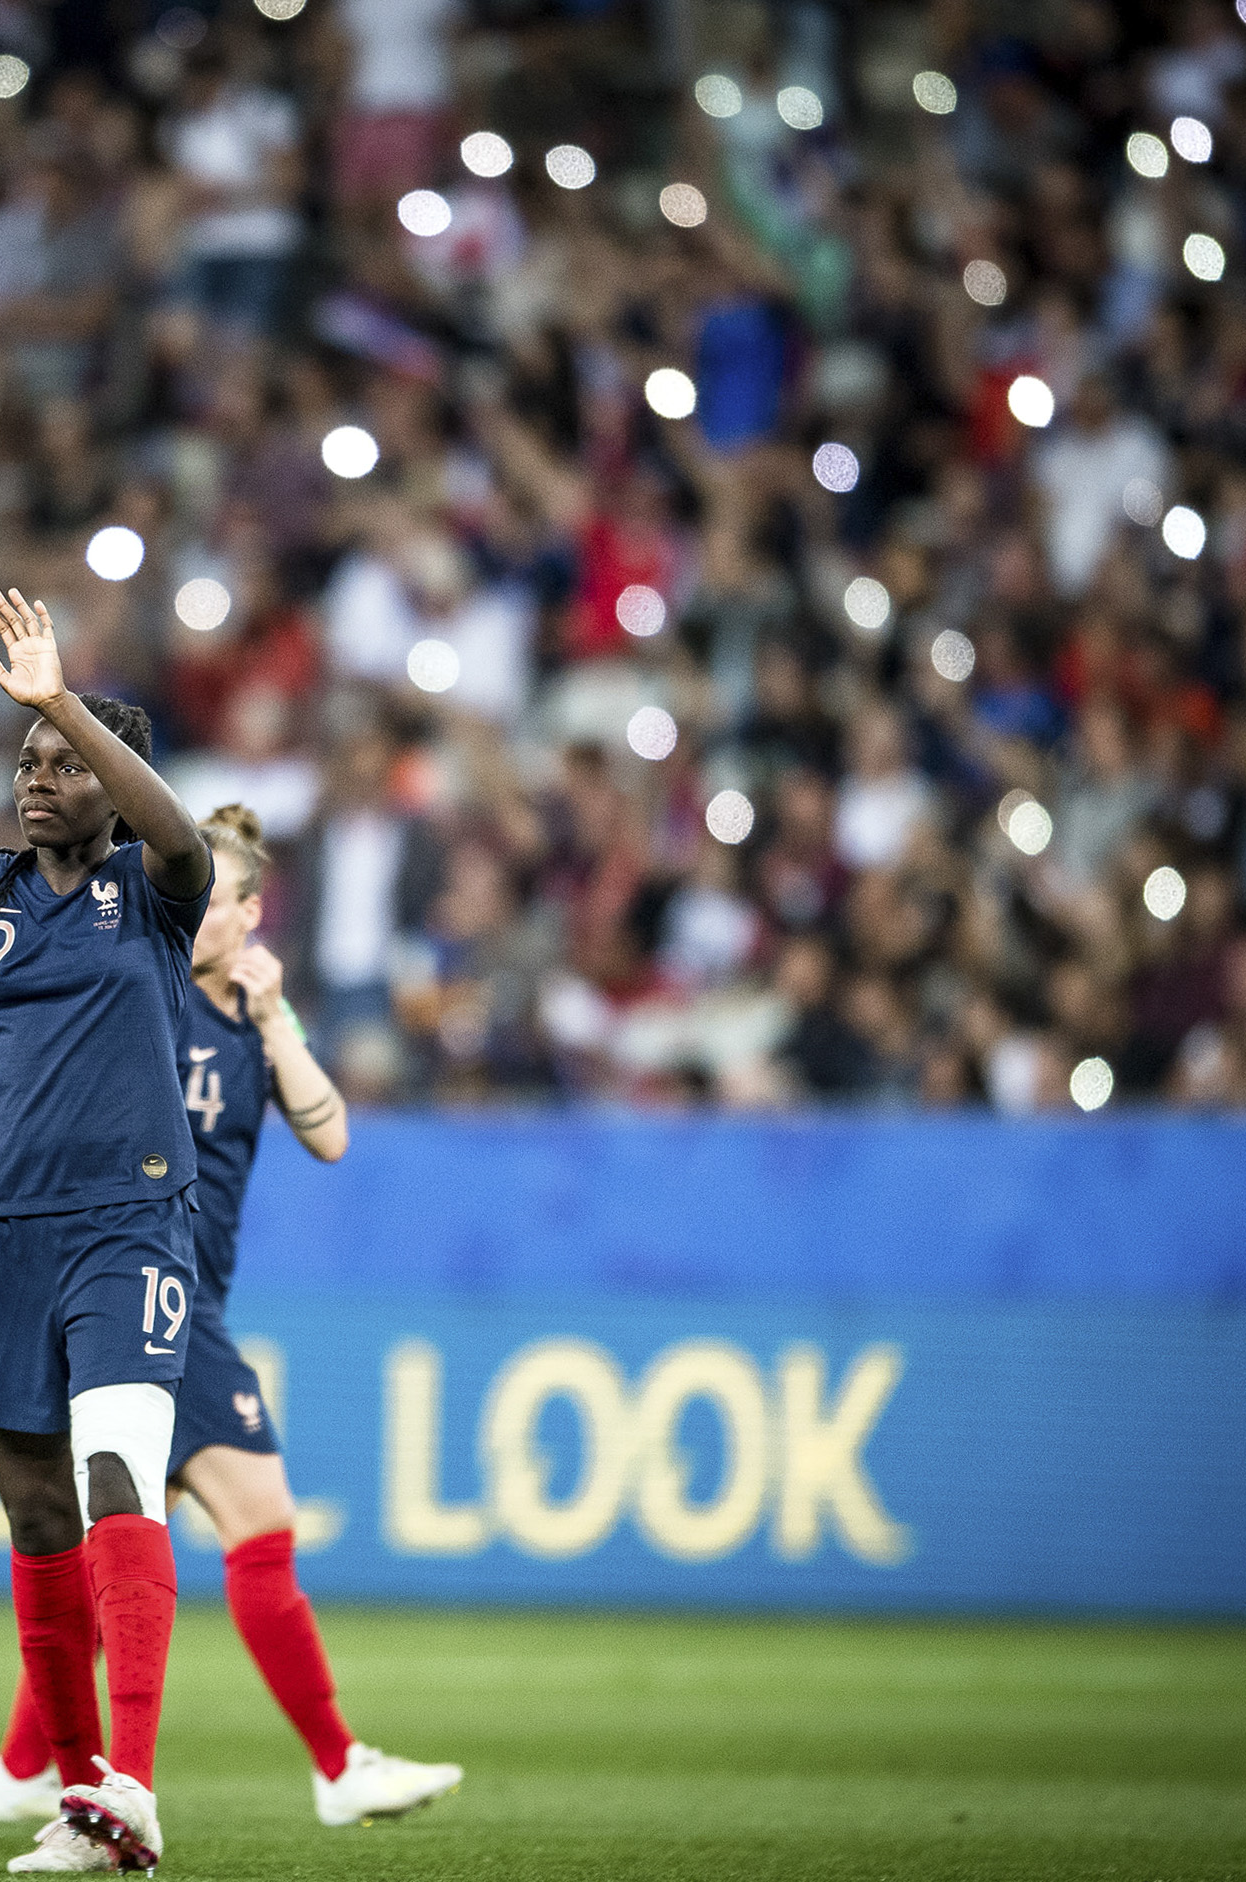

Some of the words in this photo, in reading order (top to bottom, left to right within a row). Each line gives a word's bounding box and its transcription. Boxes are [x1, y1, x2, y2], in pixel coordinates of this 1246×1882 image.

[185, 1063, 226, 1132] 4
[141, 1266, 187, 1341] 19
[381, 1337, 914, 1565] LOOK
